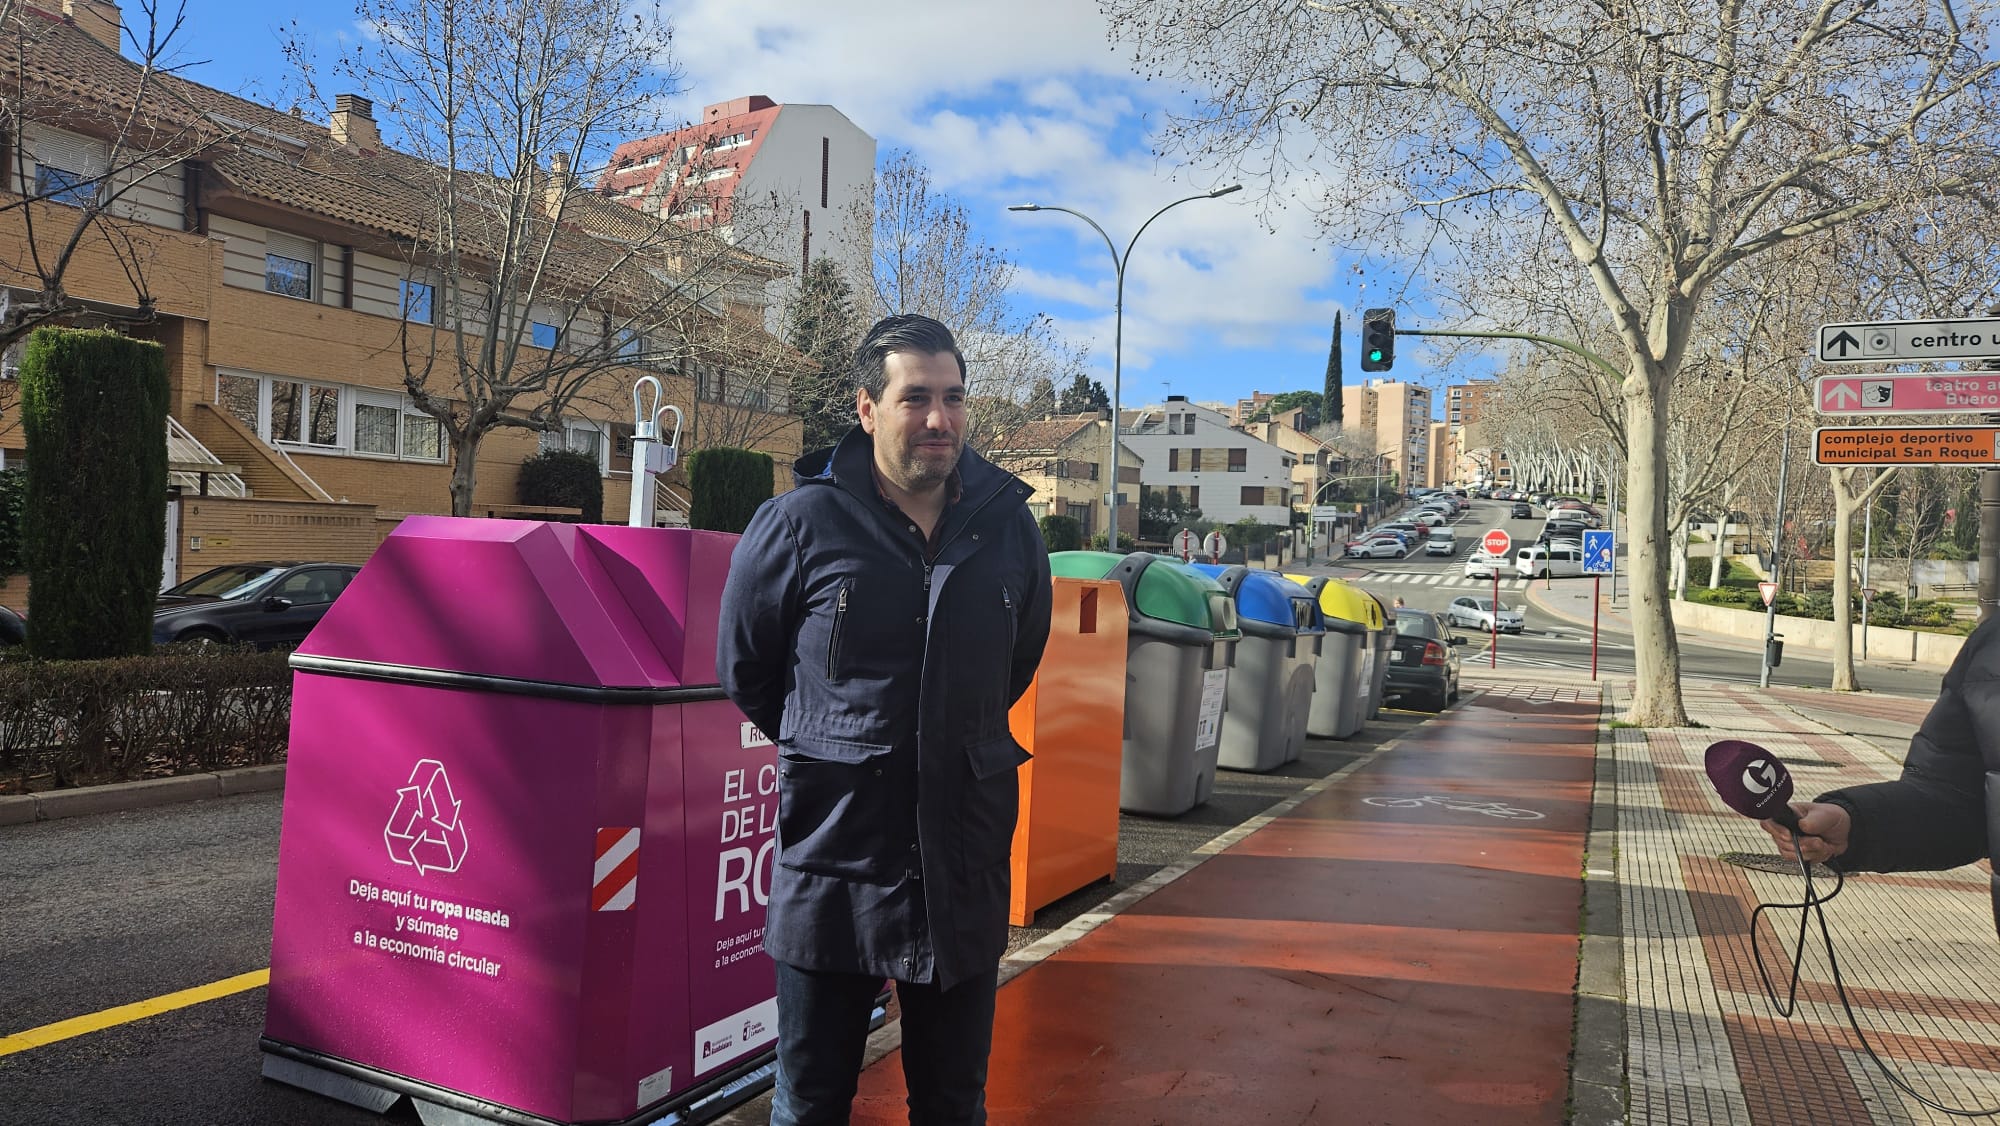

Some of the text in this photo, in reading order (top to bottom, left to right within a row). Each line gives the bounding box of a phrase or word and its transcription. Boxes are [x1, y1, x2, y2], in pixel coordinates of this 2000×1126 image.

[1911, 332, 1981, 348] centro
[1925, 379, 2000, 392] teatro a
[1946, 393, 1998, 405] Buero
[1825, 432, 1973, 446] complejo deportivo
[1824, 447, 1989, 459] municipal San Roque
[724, 768, 752, 803] EL
[721, 805, 755, 843] DE
[350, 879, 510, 928] Deja aquí tu ropa usada
[395, 915, 458, 941] y súmate
[716, 937, 734, 952] Deja
[735, 928, 752, 944] aquí
[753, 927, 761, 937] tu
[354, 930, 501, 977] a la economía circular
[715, 959, 720, 969] a
[721, 955, 729, 966] la
